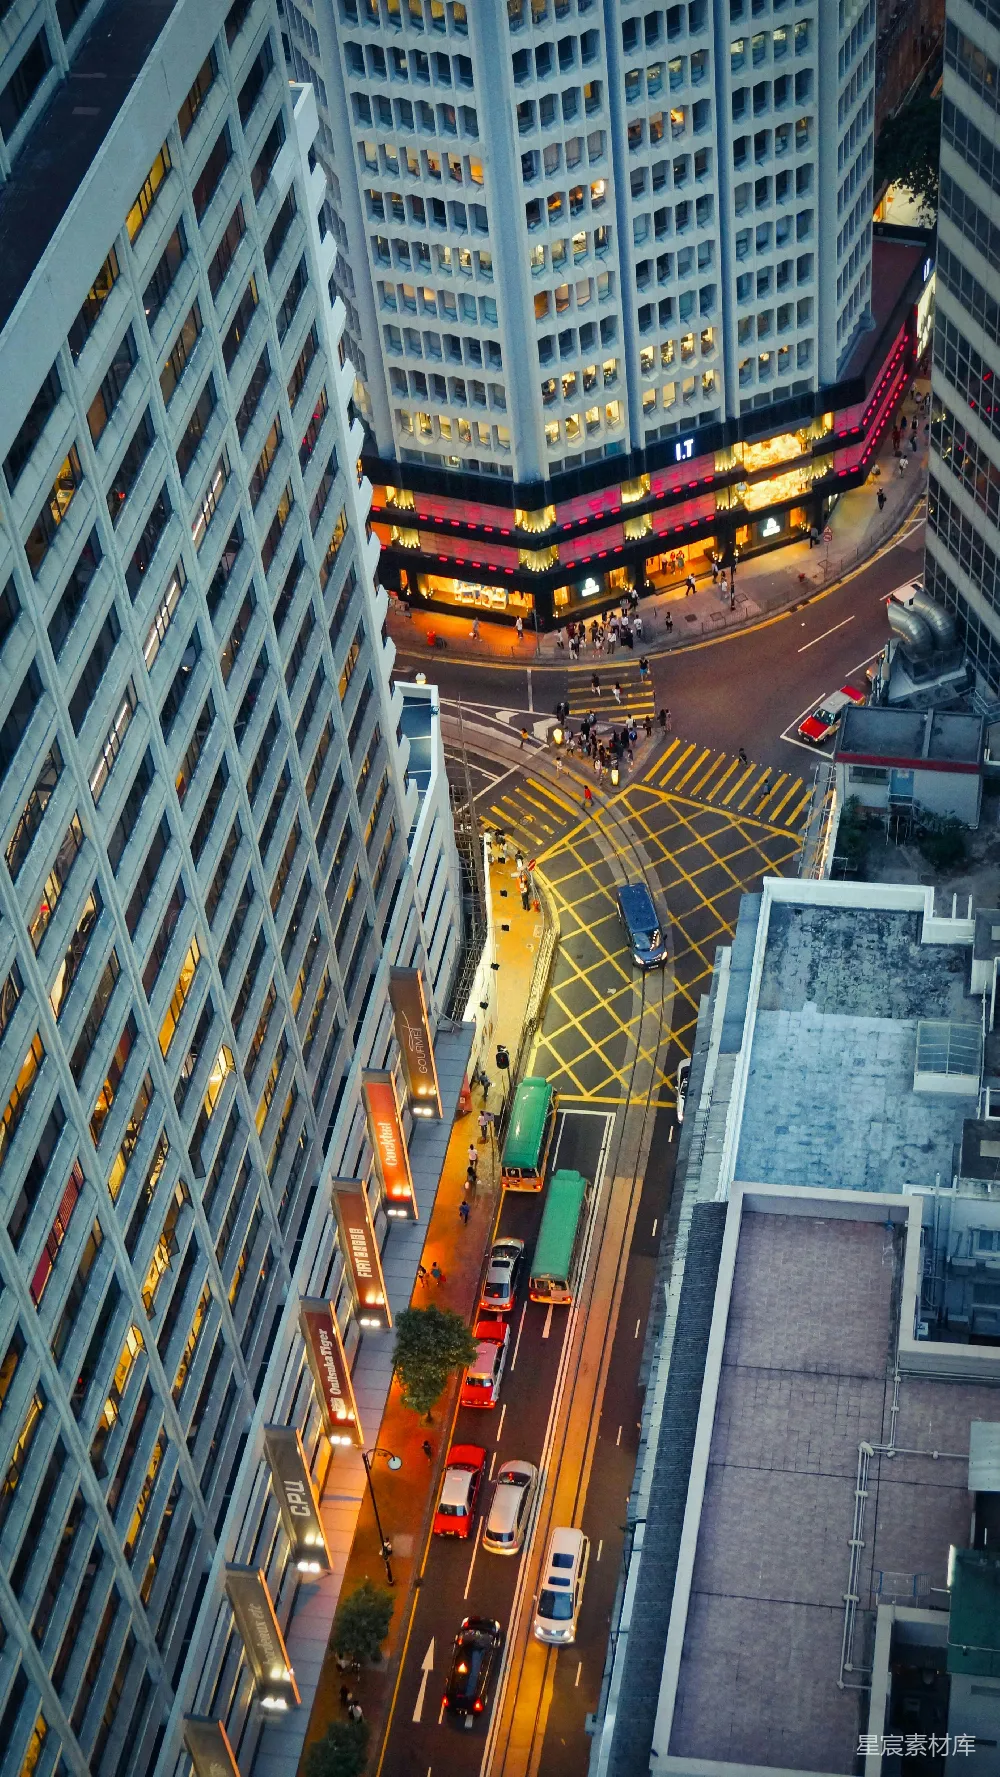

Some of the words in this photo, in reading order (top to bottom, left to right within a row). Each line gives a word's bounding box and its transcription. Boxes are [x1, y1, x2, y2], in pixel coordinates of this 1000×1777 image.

[675, 438, 694, 461] I.T
[354, 1257, 373, 1278] FIAT
[319, 1328, 333, 1356] Tiger
[324, 1355, 342, 1395] Onitsuka
